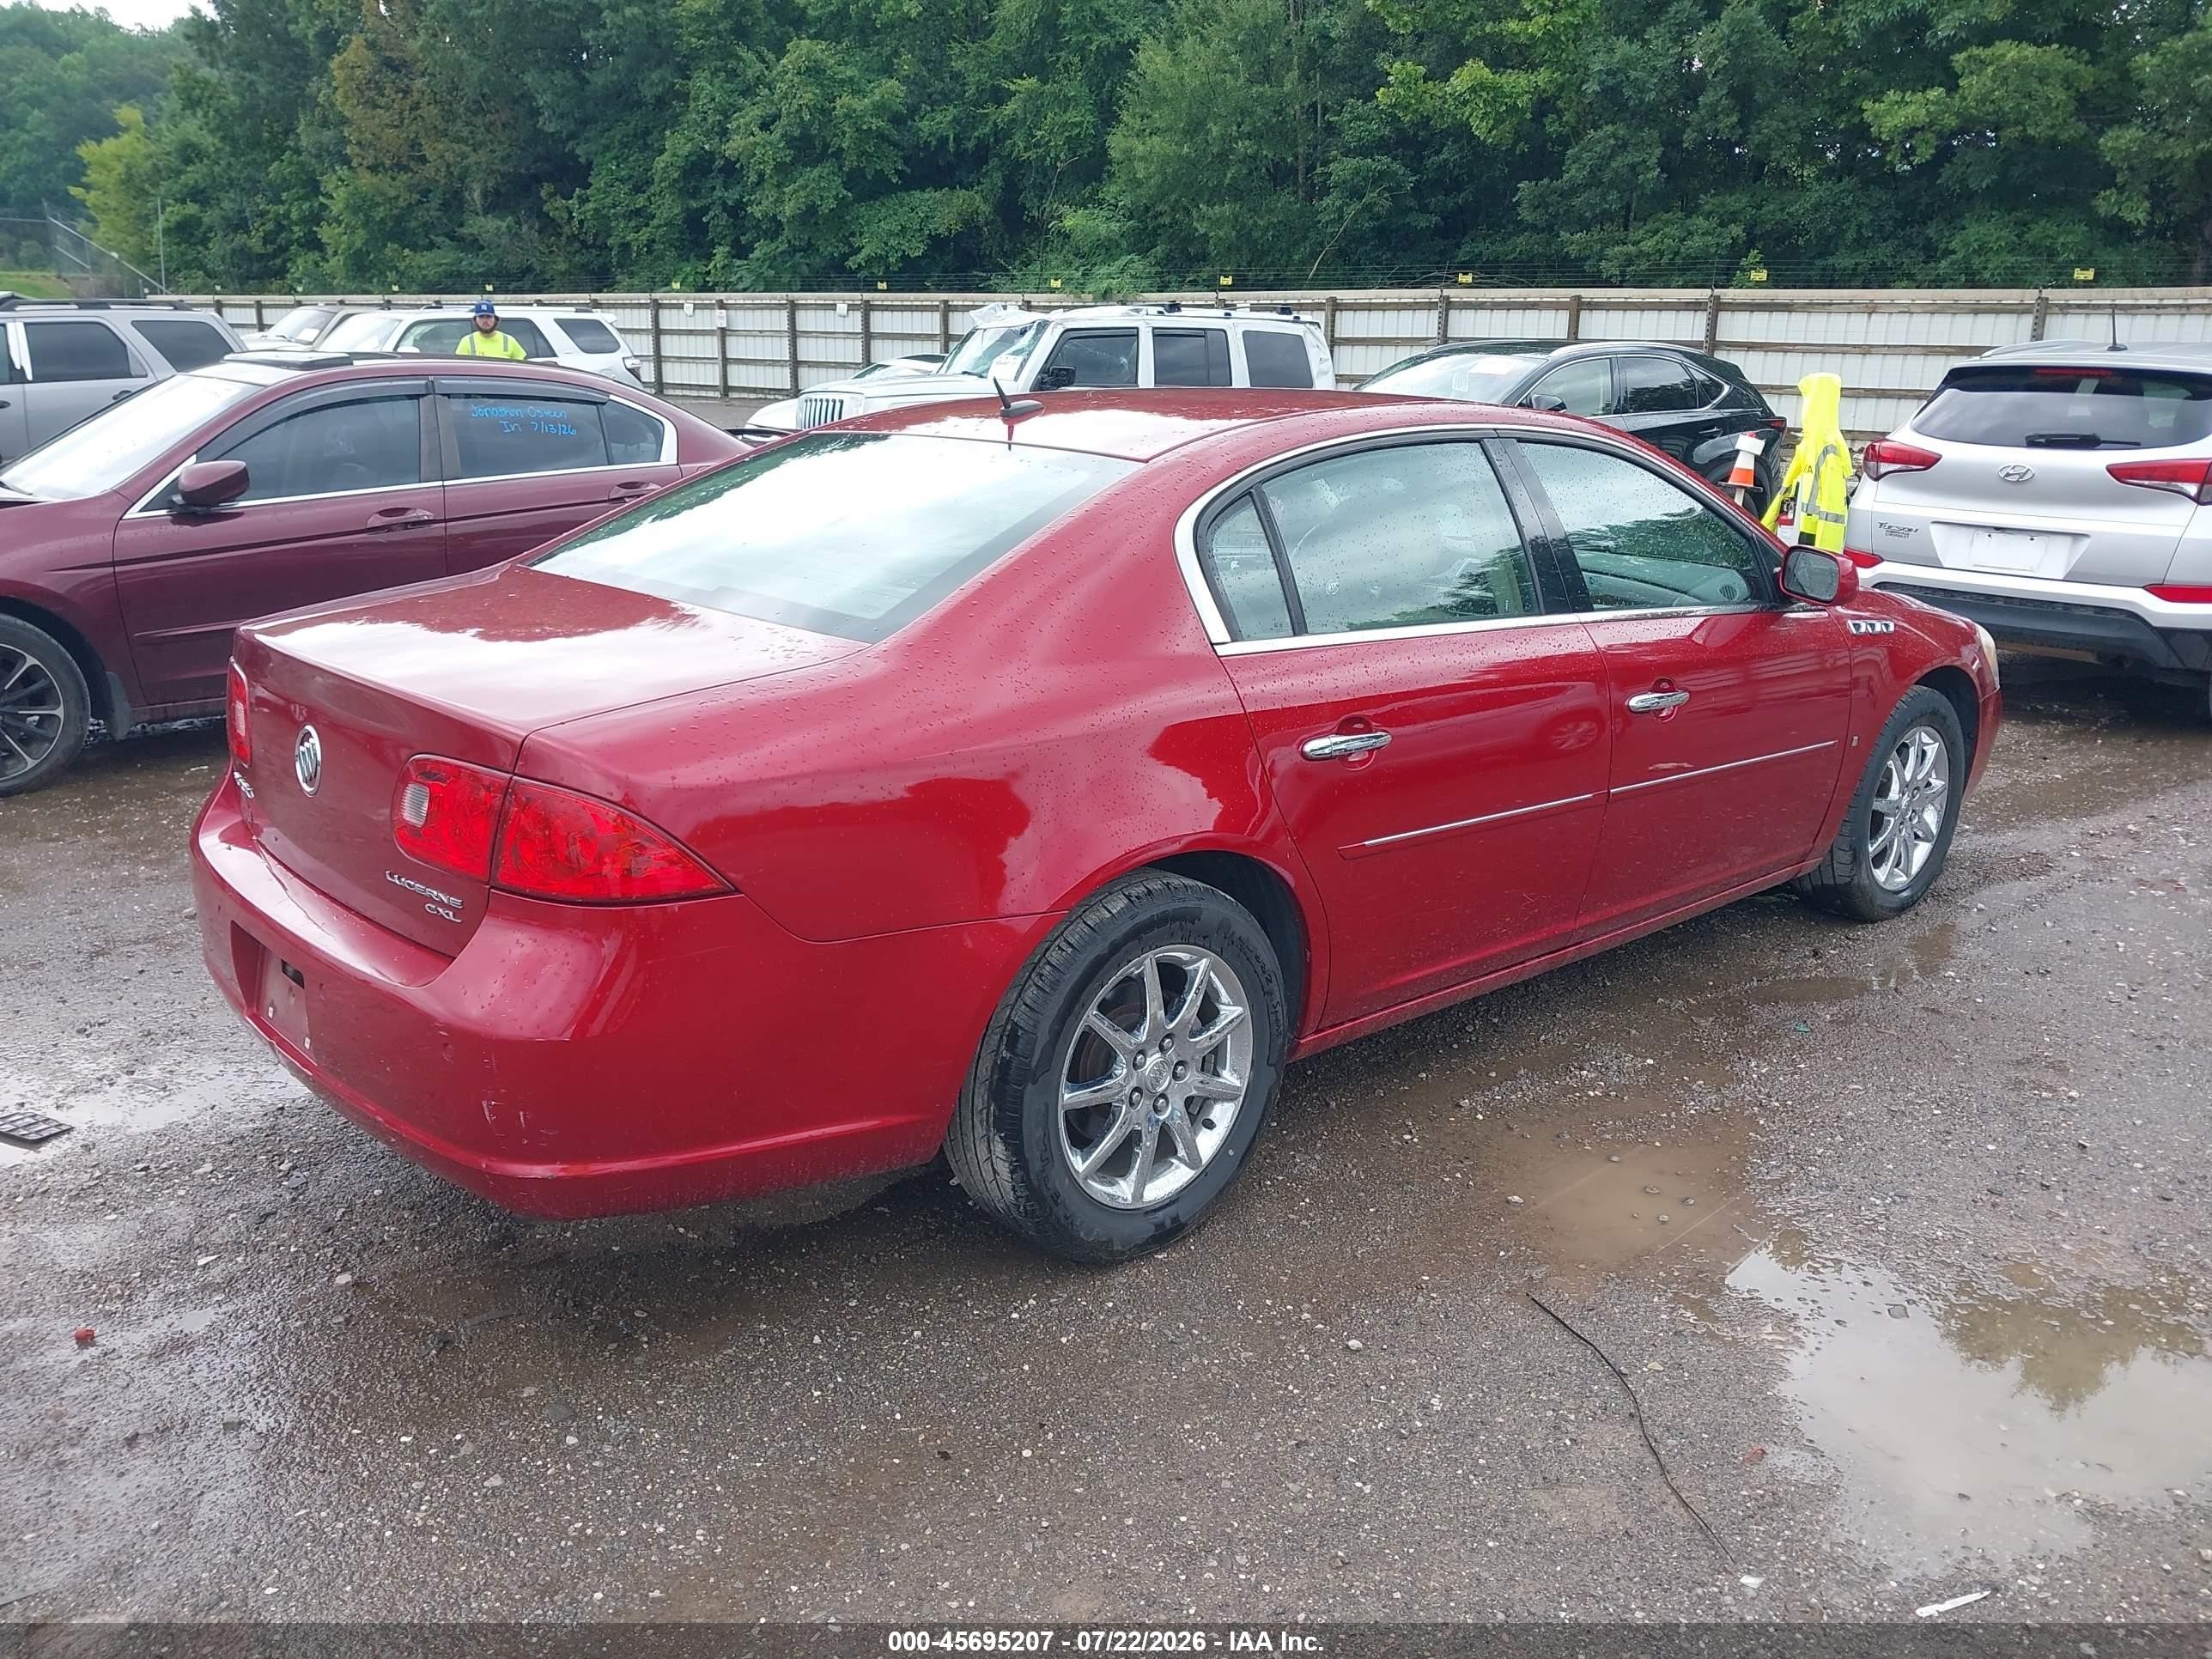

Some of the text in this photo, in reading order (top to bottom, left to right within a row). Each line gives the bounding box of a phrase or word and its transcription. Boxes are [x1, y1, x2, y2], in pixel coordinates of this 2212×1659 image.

[500, 421, 522, 433] In
[385, 870, 464, 909] LUCERNE
[424, 903, 463, 923] CXL
